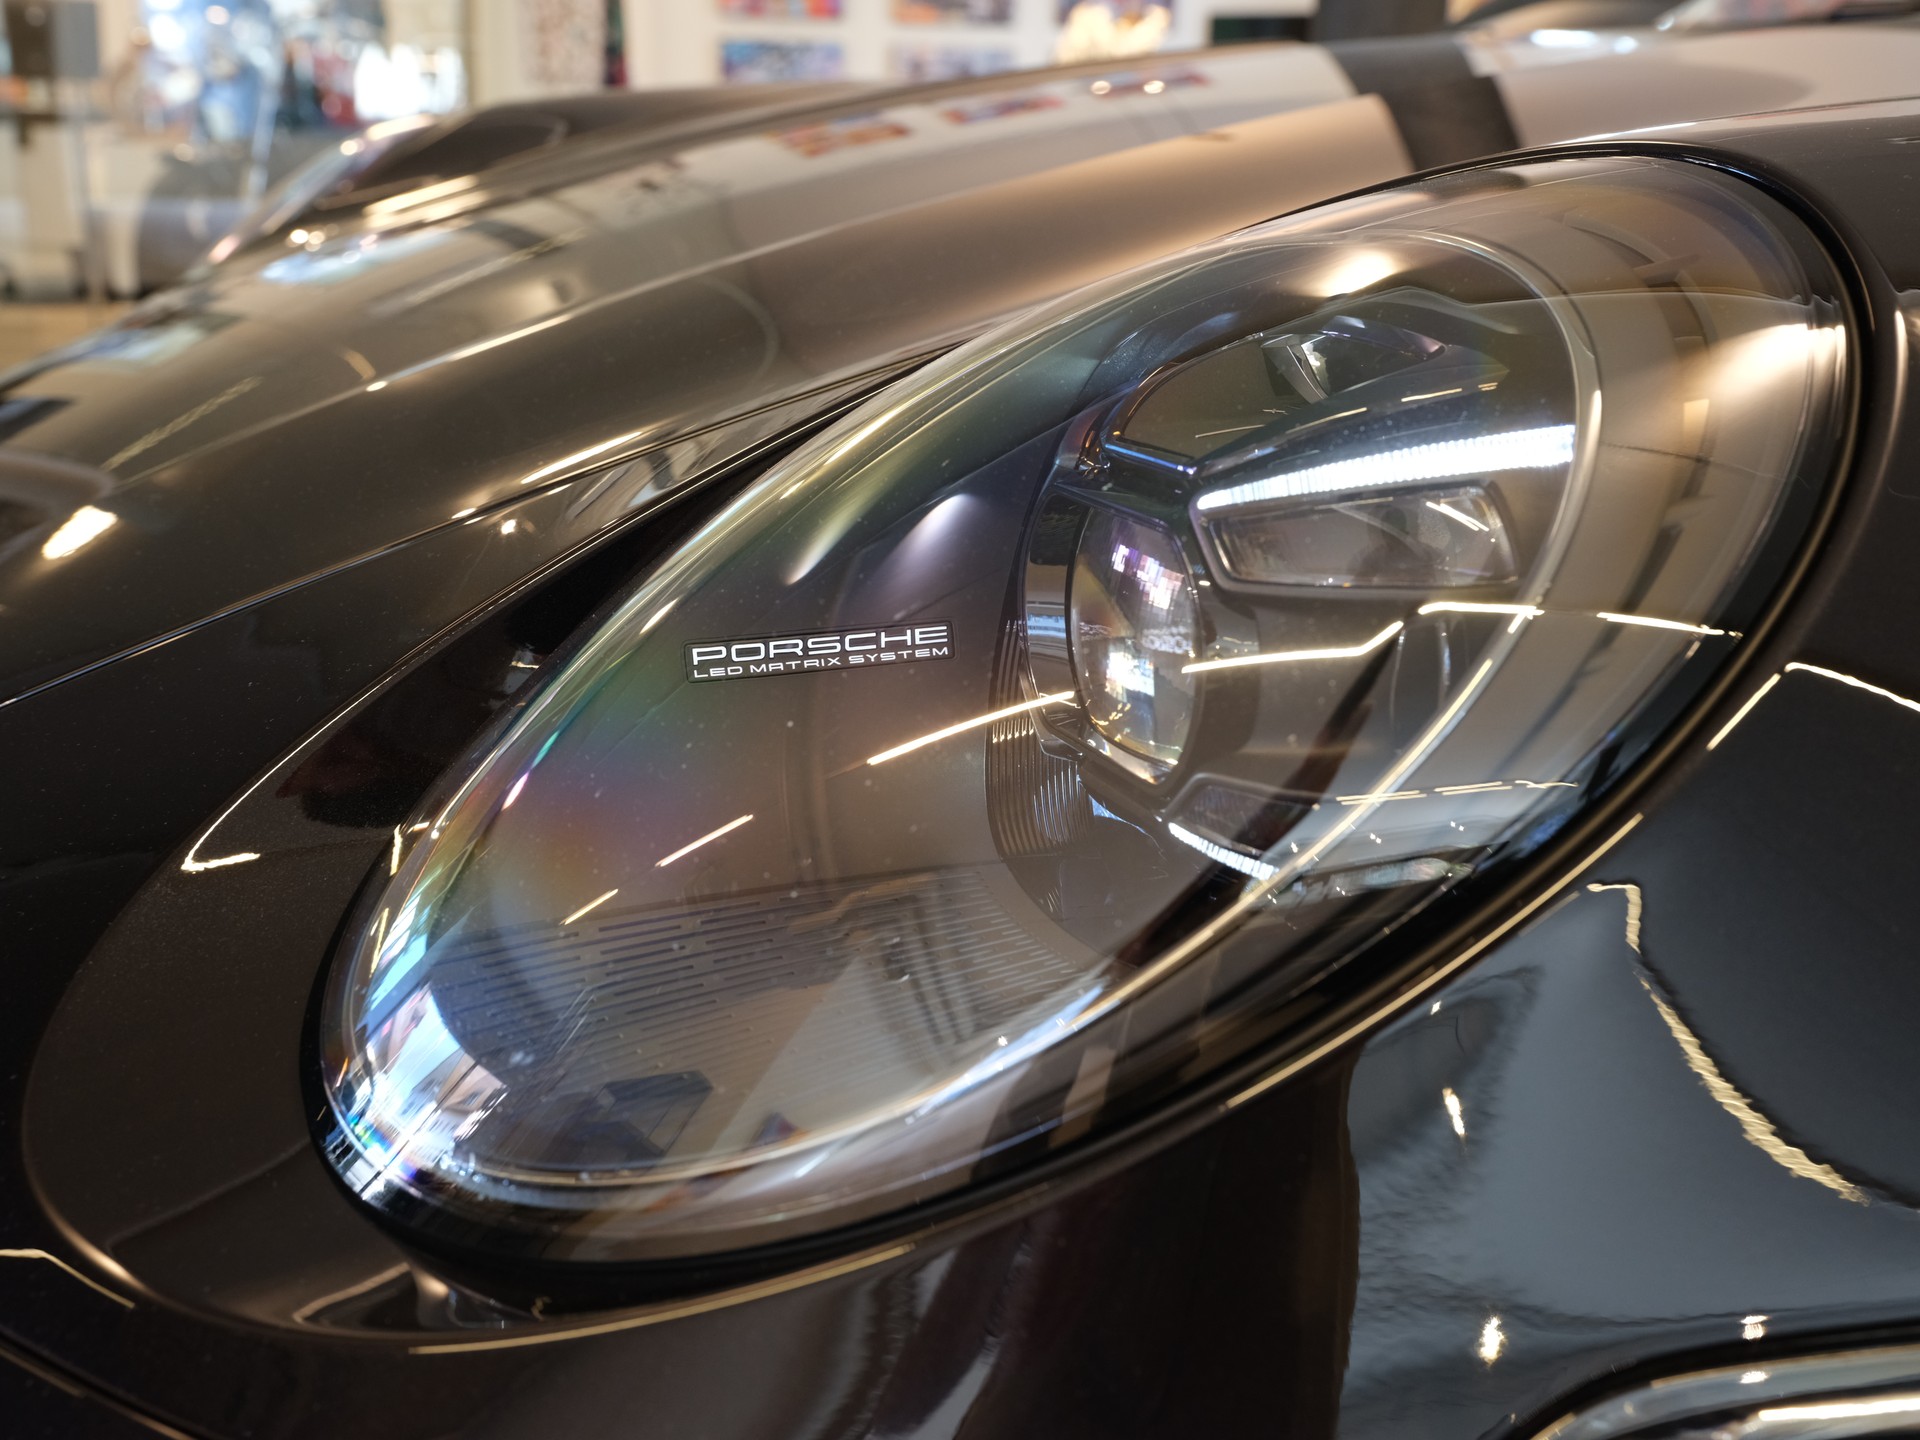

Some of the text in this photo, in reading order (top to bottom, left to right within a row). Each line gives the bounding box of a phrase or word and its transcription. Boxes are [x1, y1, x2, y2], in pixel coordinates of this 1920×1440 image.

[692, 626, 948, 665] PORSCHE
[694, 646, 949, 678] LED MATRIX SYSTEM
